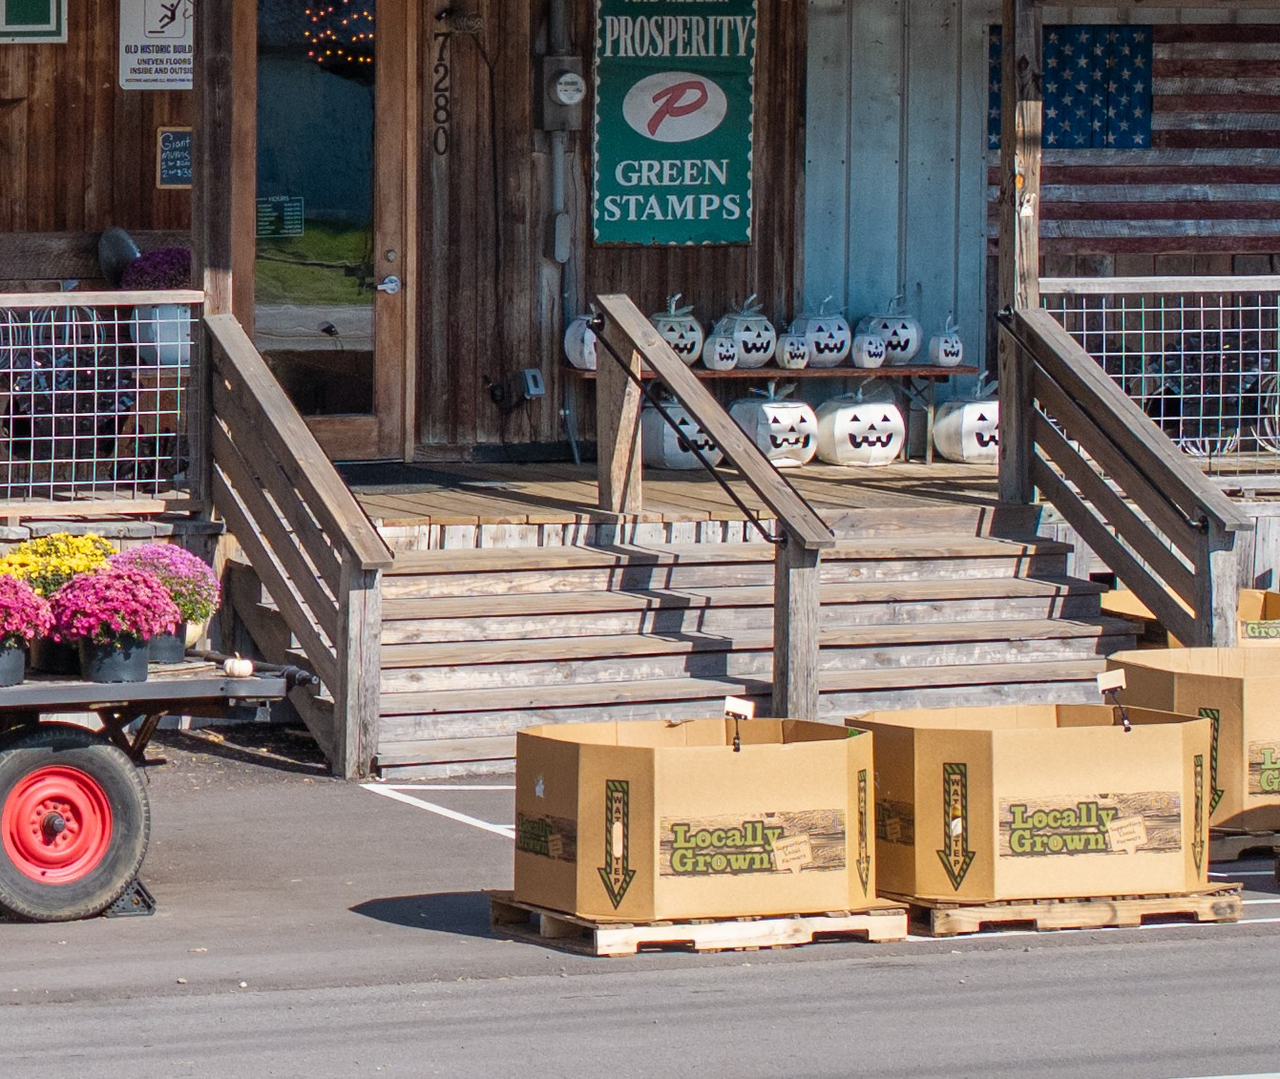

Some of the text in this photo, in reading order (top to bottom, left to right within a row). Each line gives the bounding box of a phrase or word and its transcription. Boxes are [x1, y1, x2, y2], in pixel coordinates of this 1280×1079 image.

[602, 15, 753, 57] PROSPERITY
[125, 44, 193, 54] OLD HISTORIC BUILD
[130, 67, 193, 75] INSIDE AND OUTSI
[137, 58, 192, 66] UNEVEN FLOORS
[646, 80, 709, 137] P
[160, 132, 191, 151] Giant
[614, 159, 730, 187] GREEN
[603, 193, 741, 221] STAMPS
[1246, 623, 1280, 638] Gro
[1010, 802, 1118, 832] Locally
[671, 820, 784, 852] Locally
[1010, 829, 1107, 853] Grown
[671, 849, 773, 873] Grown
